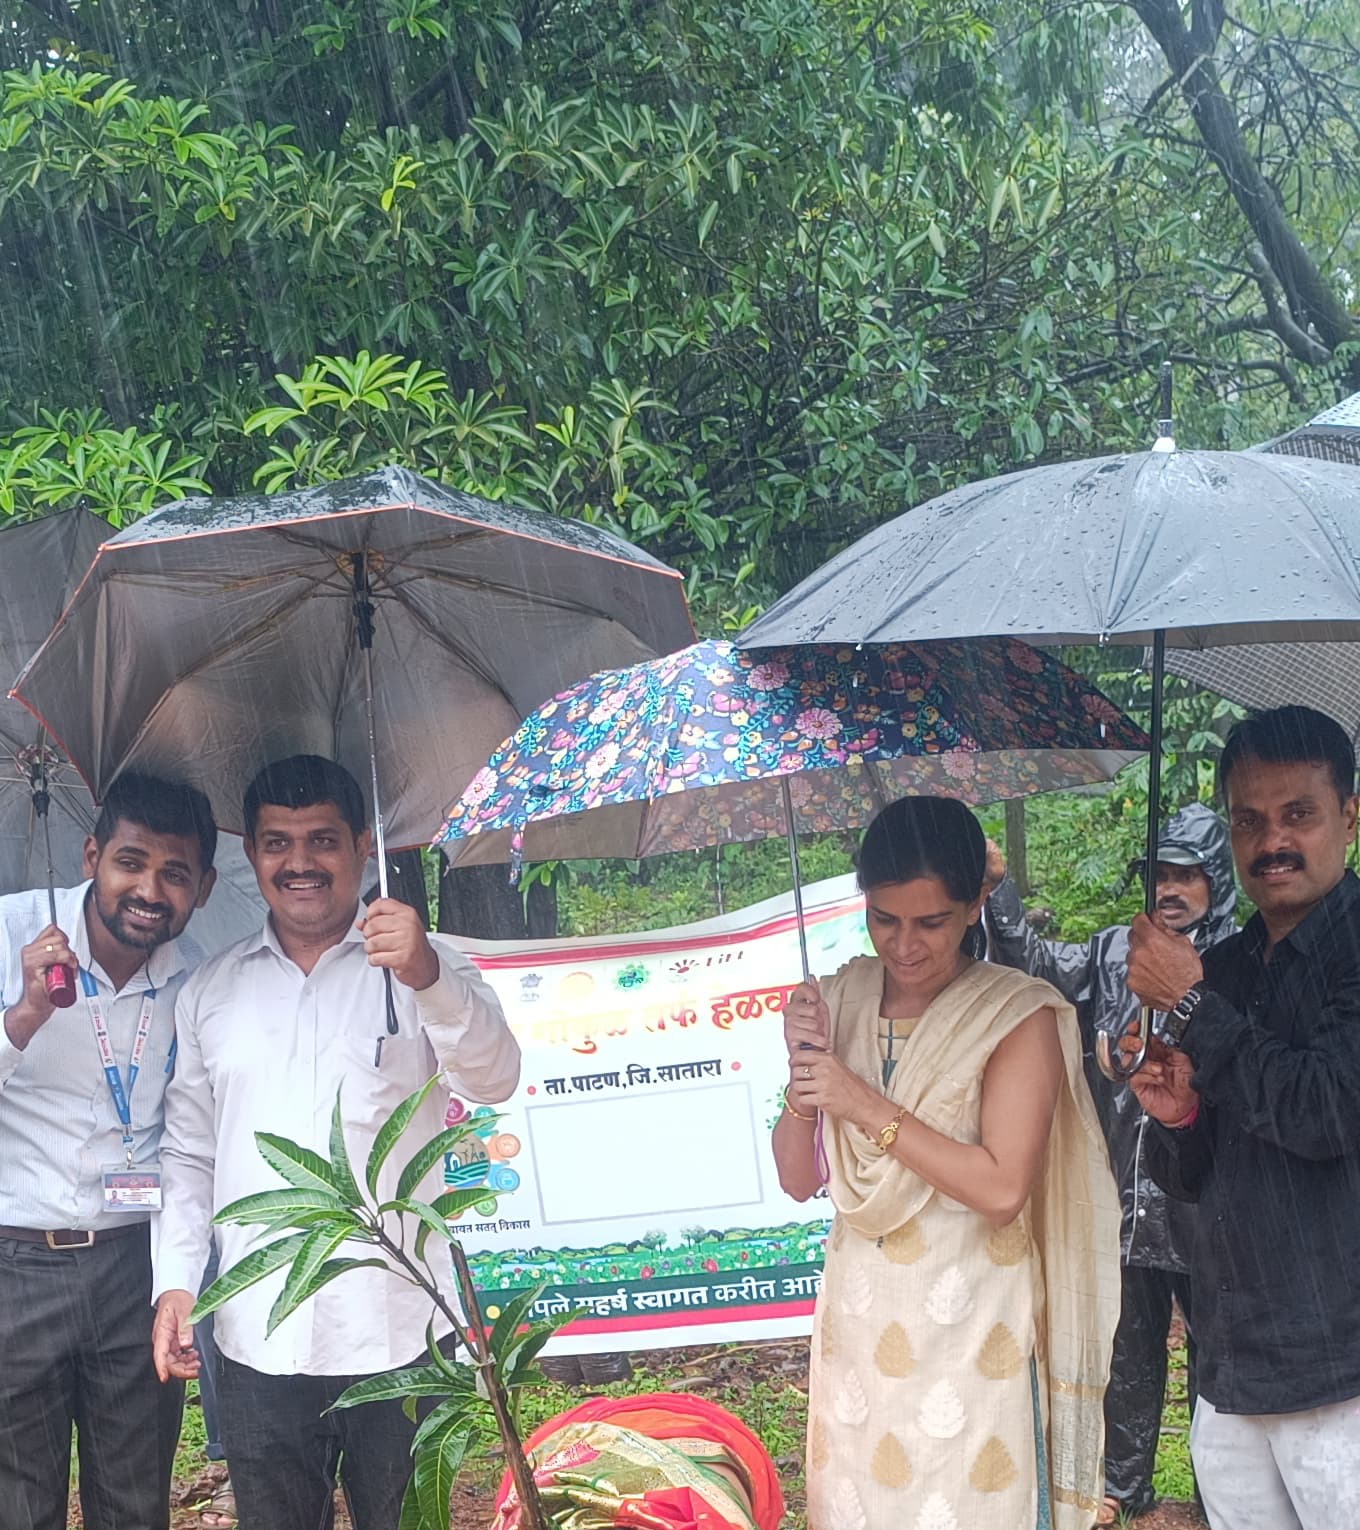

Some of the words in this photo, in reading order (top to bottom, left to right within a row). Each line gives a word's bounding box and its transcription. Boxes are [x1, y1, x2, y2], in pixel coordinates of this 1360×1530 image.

[498, 1218, 530, 1232] विकास
[572, 1287, 629, 1316] सहर्ष
[631, 1286, 709, 1310] स्वागत
[711, 1276, 777, 1302] करीत
